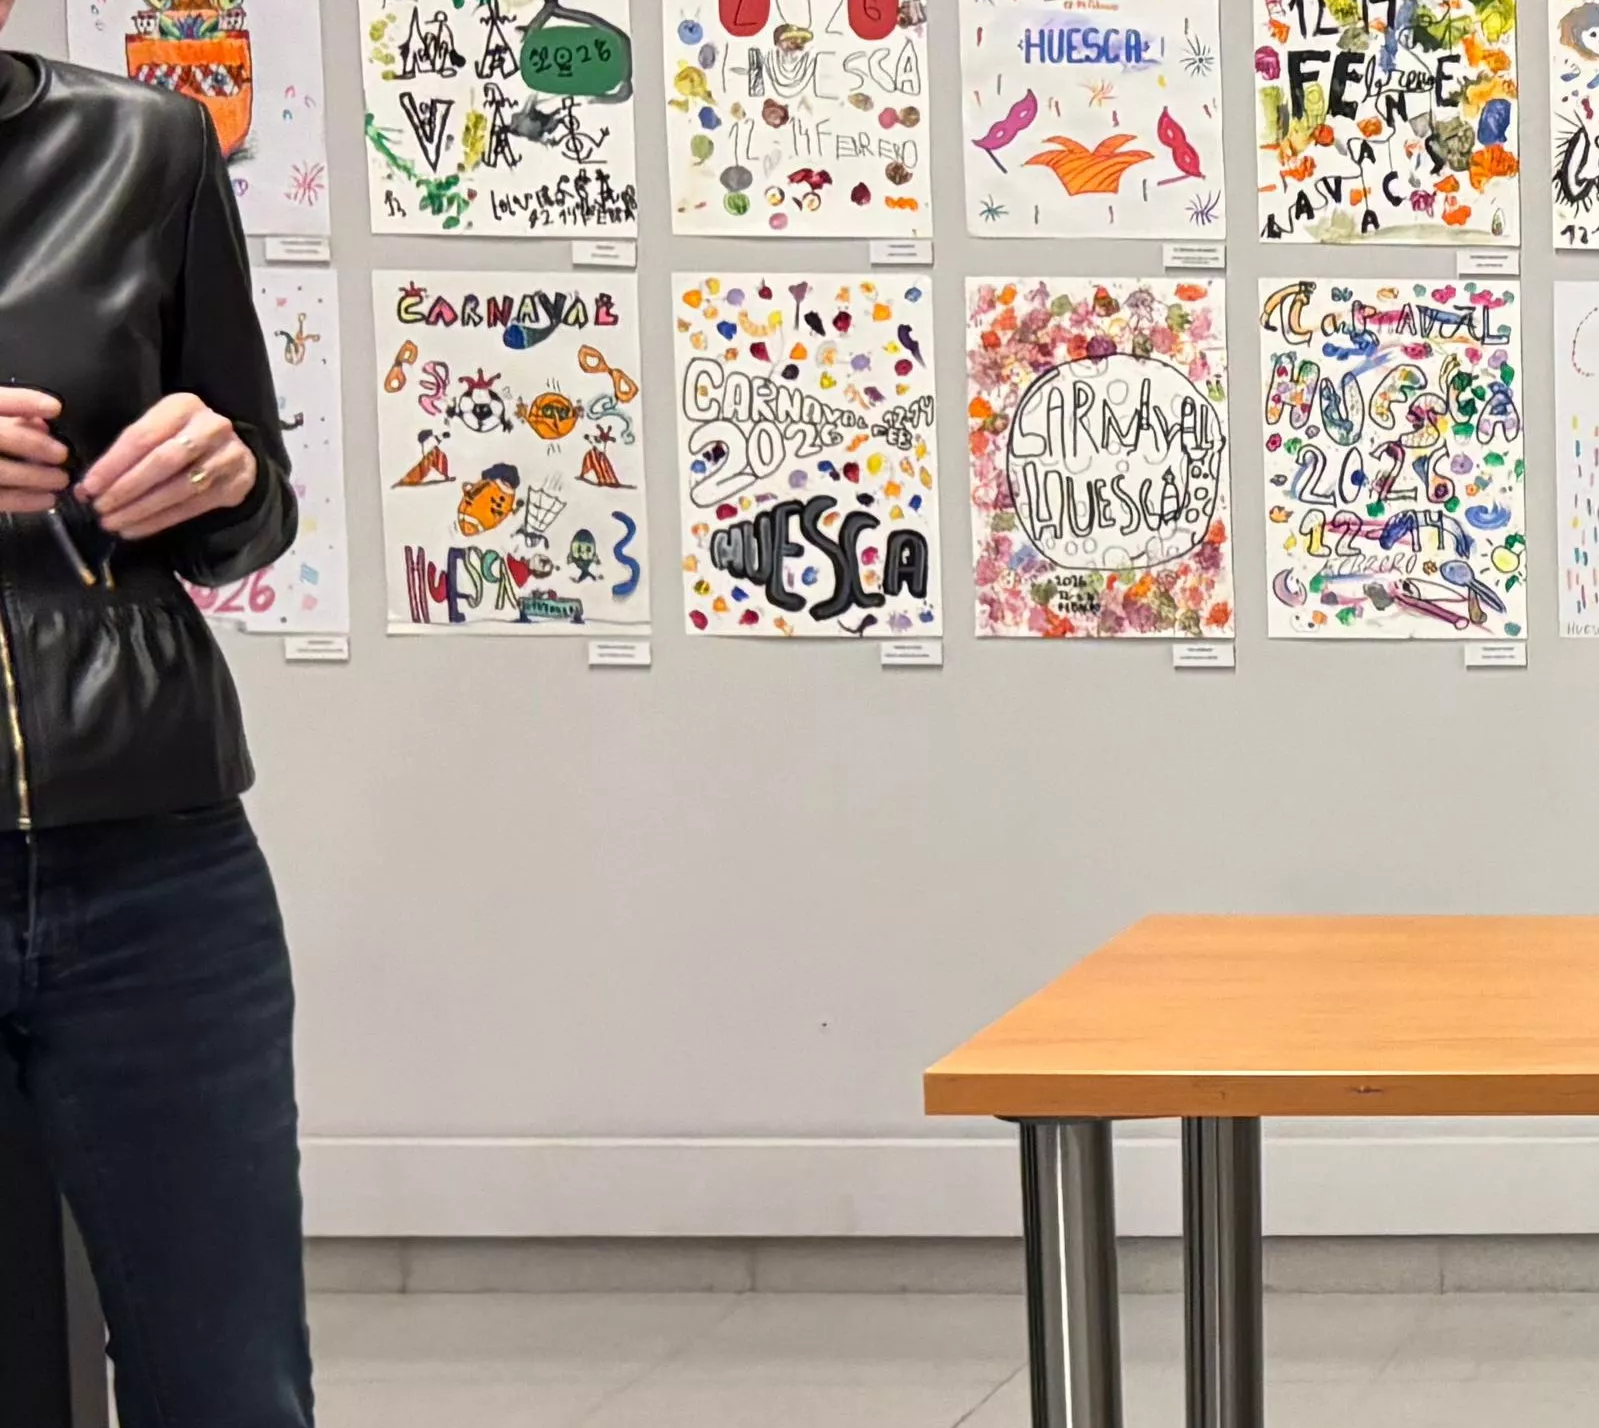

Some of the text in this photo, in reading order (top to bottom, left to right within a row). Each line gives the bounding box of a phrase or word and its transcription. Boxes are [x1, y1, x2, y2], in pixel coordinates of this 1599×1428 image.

[1024, 28, 1144, 64] HUESCA
[1295, 440, 1455, 509] 2026
[710, 495, 929, 622] HUESCA
